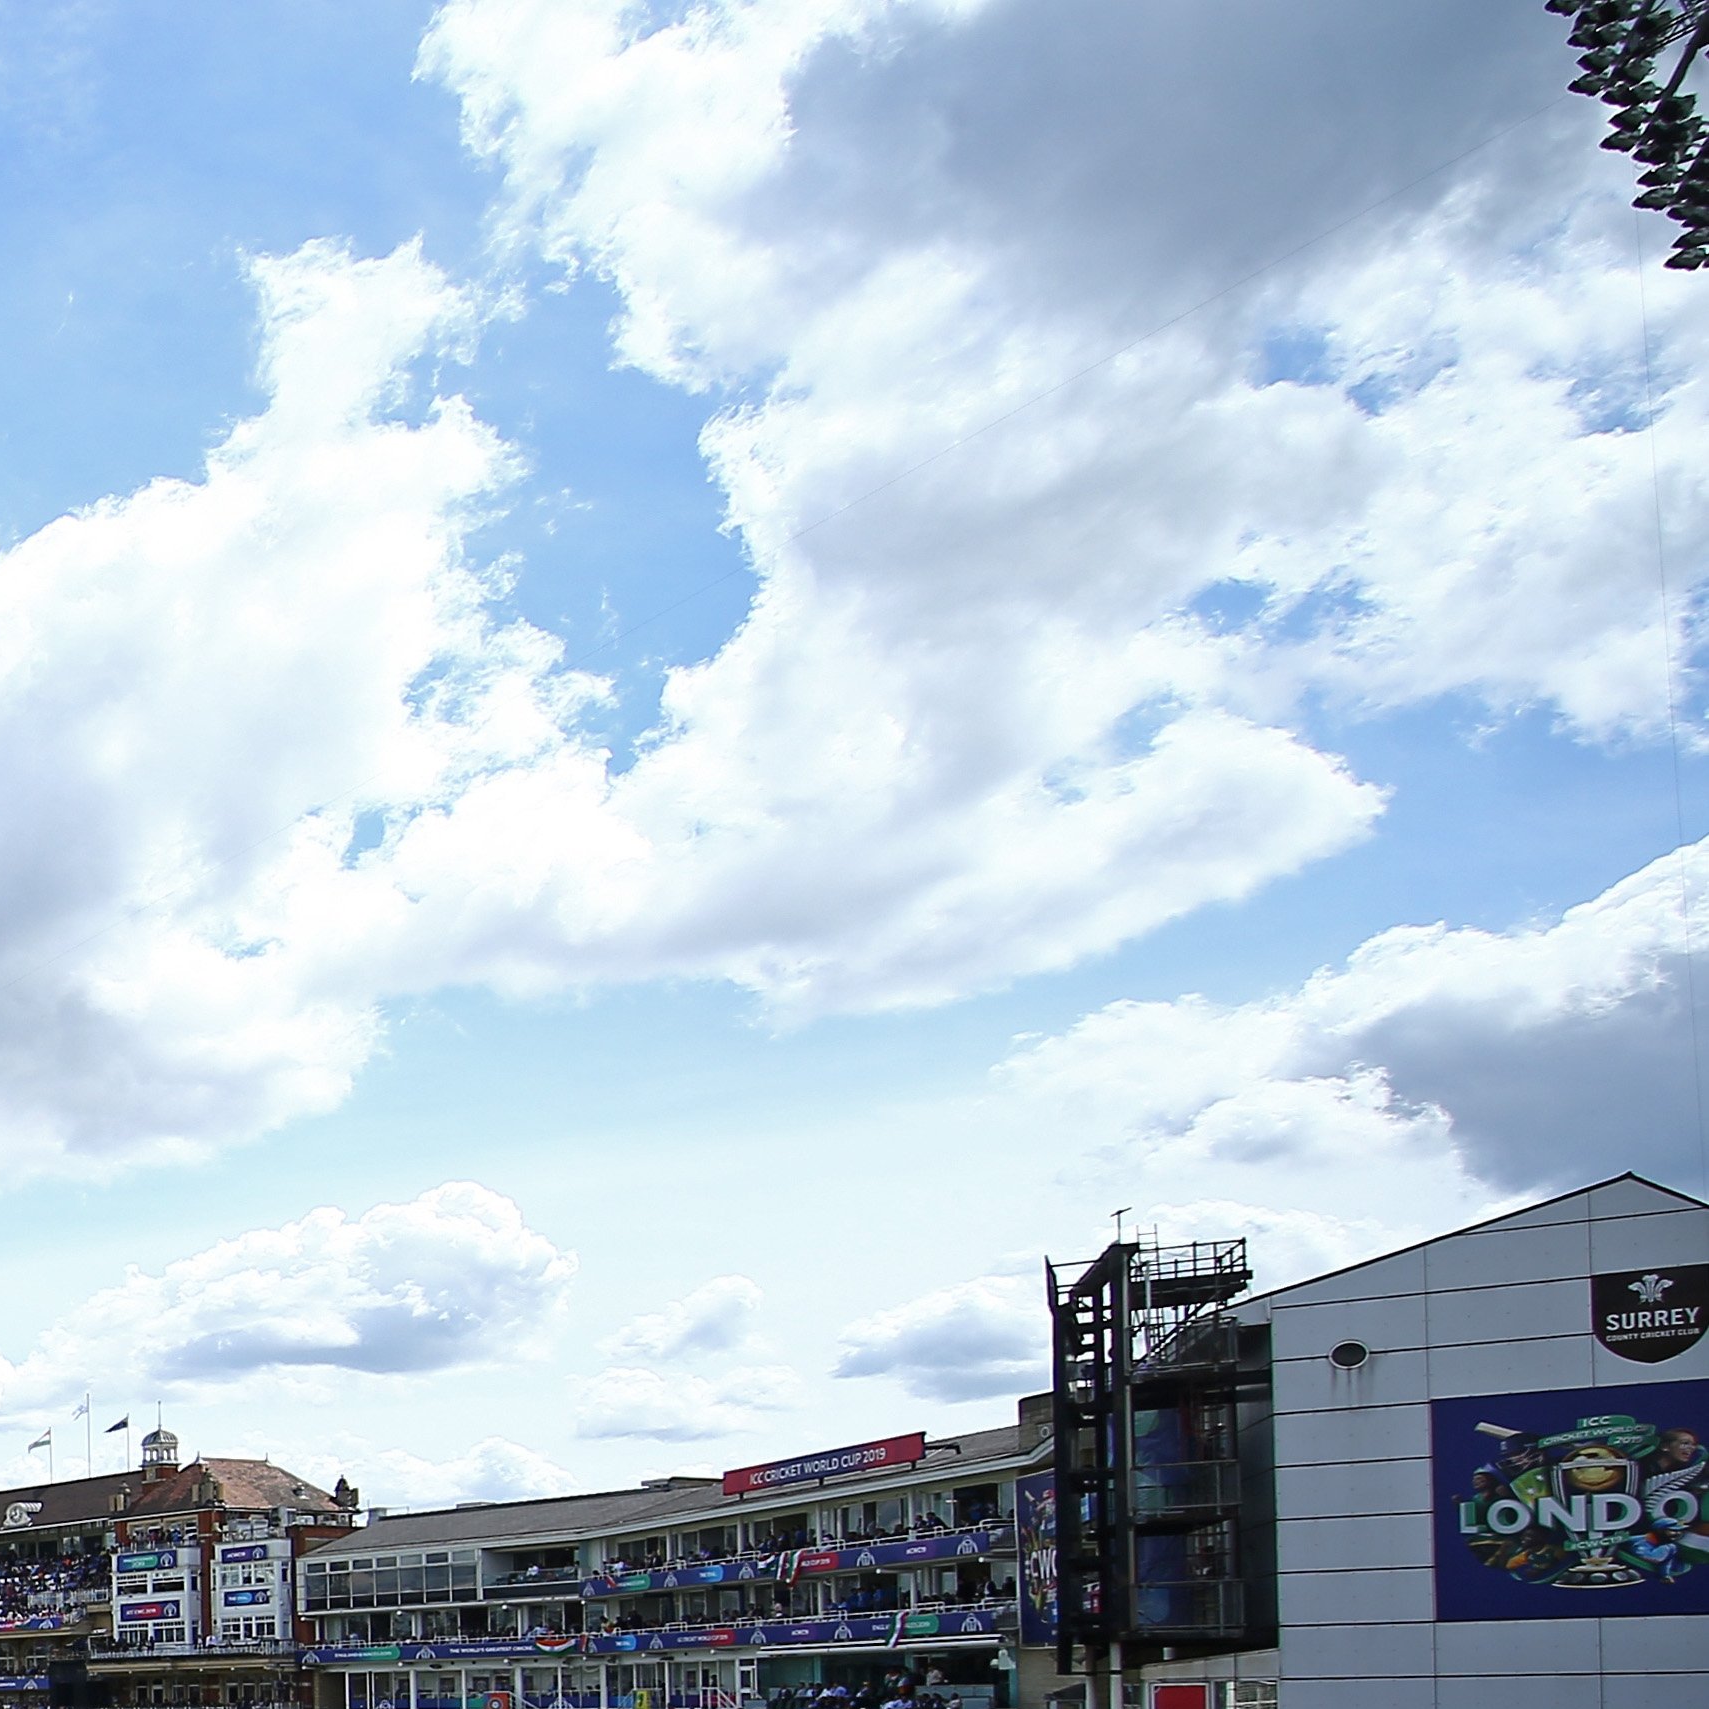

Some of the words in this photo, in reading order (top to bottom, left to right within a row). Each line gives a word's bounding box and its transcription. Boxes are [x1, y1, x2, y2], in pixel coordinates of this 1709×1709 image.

[1605, 1306, 1700, 1331] SURREY
[1605, 1333, 1638, 1342] COUNTY
[1640, 1329, 1676, 1339] CRICKET
[1677, 1327, 1700, 1337] CLUB
[1582, 1416, 1611, 1427] ICC
[749, 1471, 763, 1485] ICC
[764, 1463, 801, 1482] CRICKET
[803, 1457, 838, 1473] WORLD
[840, 1453, 862, 1468] CUP
[862, 1447, 886, 1463] 2019
[1459, 1491, 1699, 1534] LONDO
[1025, 1549, 1057, 1579] #CWC
